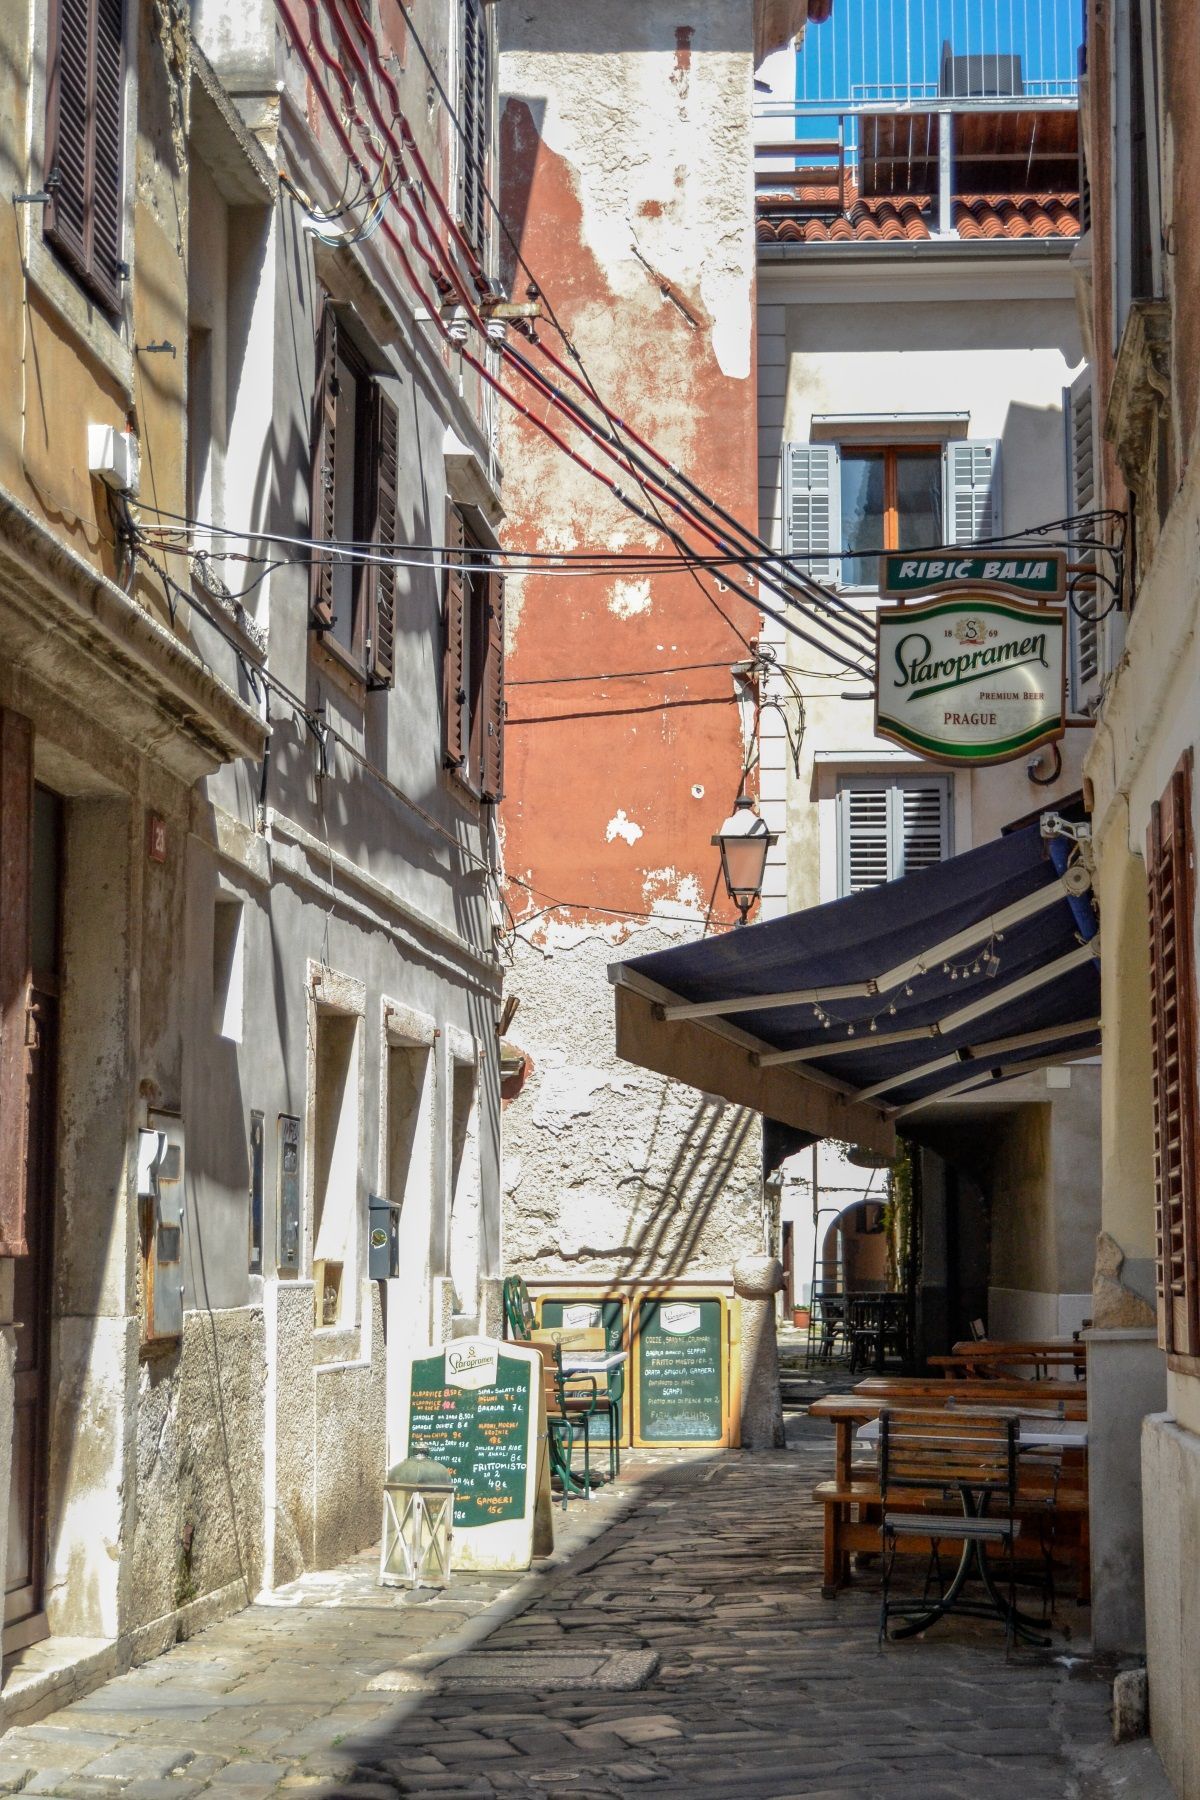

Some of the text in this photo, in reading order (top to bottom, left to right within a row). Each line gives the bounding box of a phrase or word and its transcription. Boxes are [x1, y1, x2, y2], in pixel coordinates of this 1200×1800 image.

[899, 559, 1048, 578] RIBIČ BAJA
[944, 630, 952, 638] 18
[988, 630, 998, 638] 69
[894, 633, 1048, 688] Staropramen
[980, 692, 1044, 700] PREMIUM BEER
[944, 712, 997, 725] PRAGUE
[448, 1352, 494, 1375] Staropramen
[476, 1496, 512, 1506] GAMBERI
